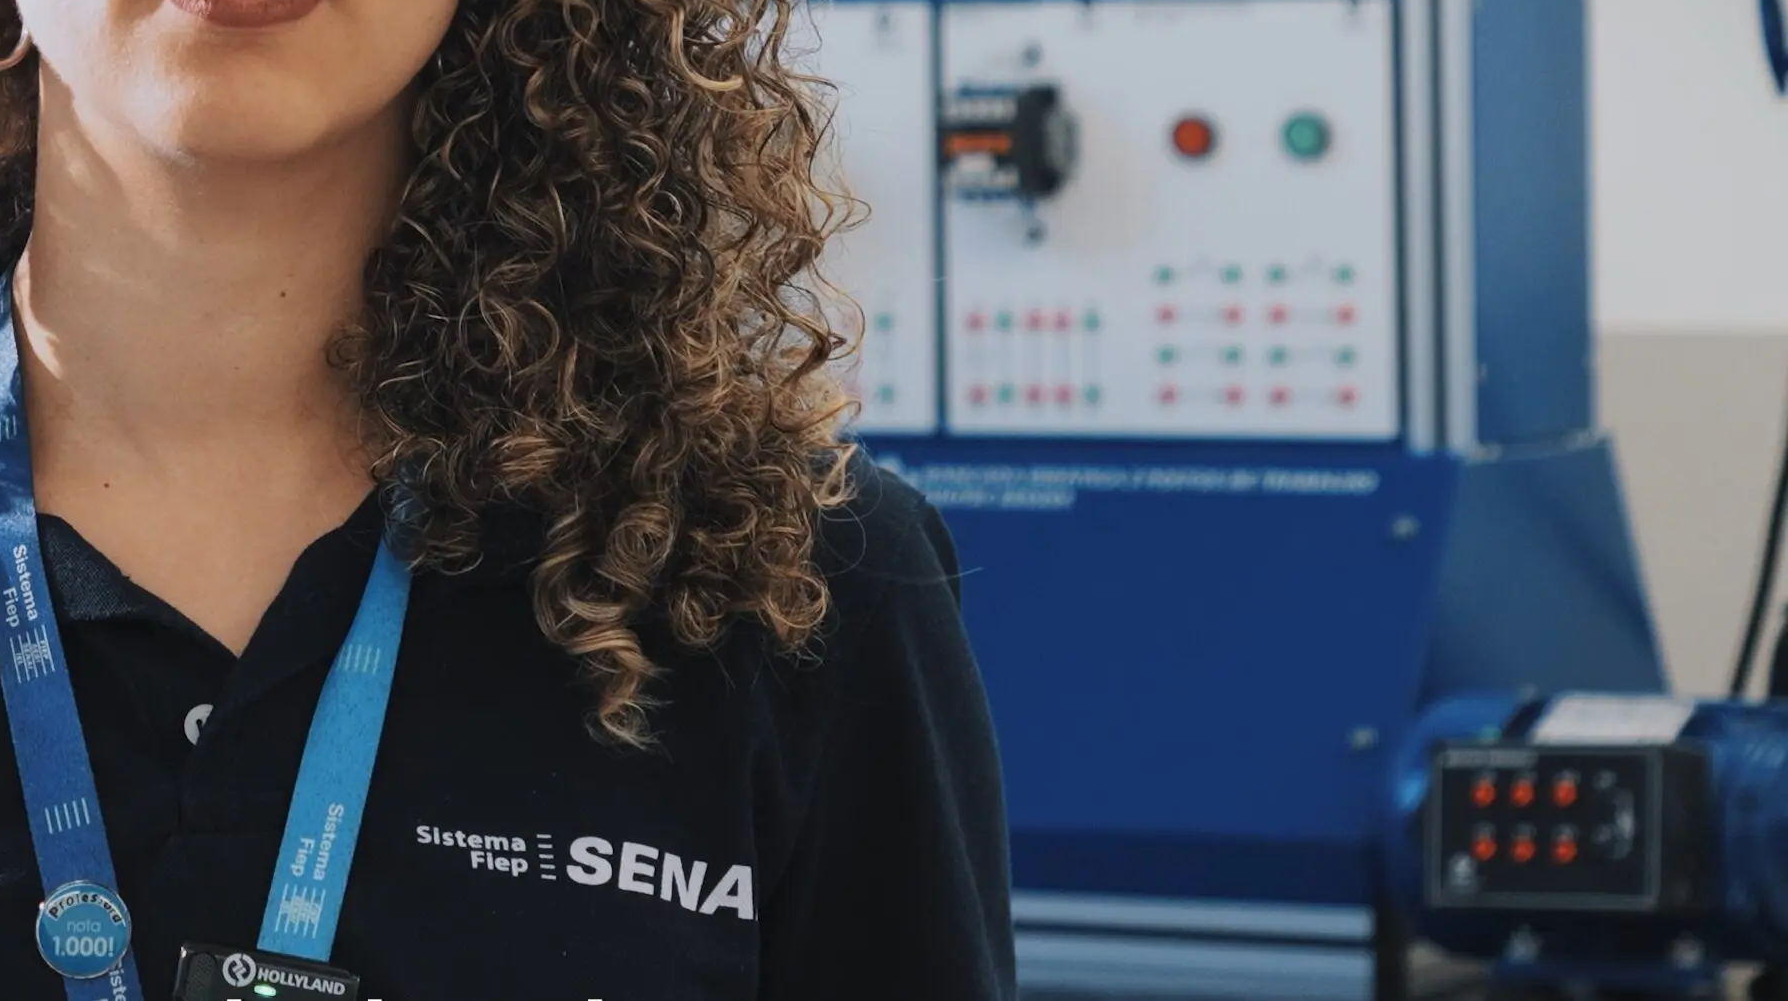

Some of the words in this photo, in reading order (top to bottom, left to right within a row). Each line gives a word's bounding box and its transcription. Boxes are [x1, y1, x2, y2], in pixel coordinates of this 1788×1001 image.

[13, 543, 38, 621] Sistema
[3, 586, 20, 628] Fiep
[313, 802, 344, 881] Sistema
[416, 824, 527, 852] Sistema
[289, 837, 315, 877] Fiep
[470, 850, 529, 877] Fiep
[566, 835, 759, 921] SENA
[66, 918, 101, 933] nota
[52, 936, 115, 957] 1.000!
[257, 966, 346, 996] HOLLYLAND
